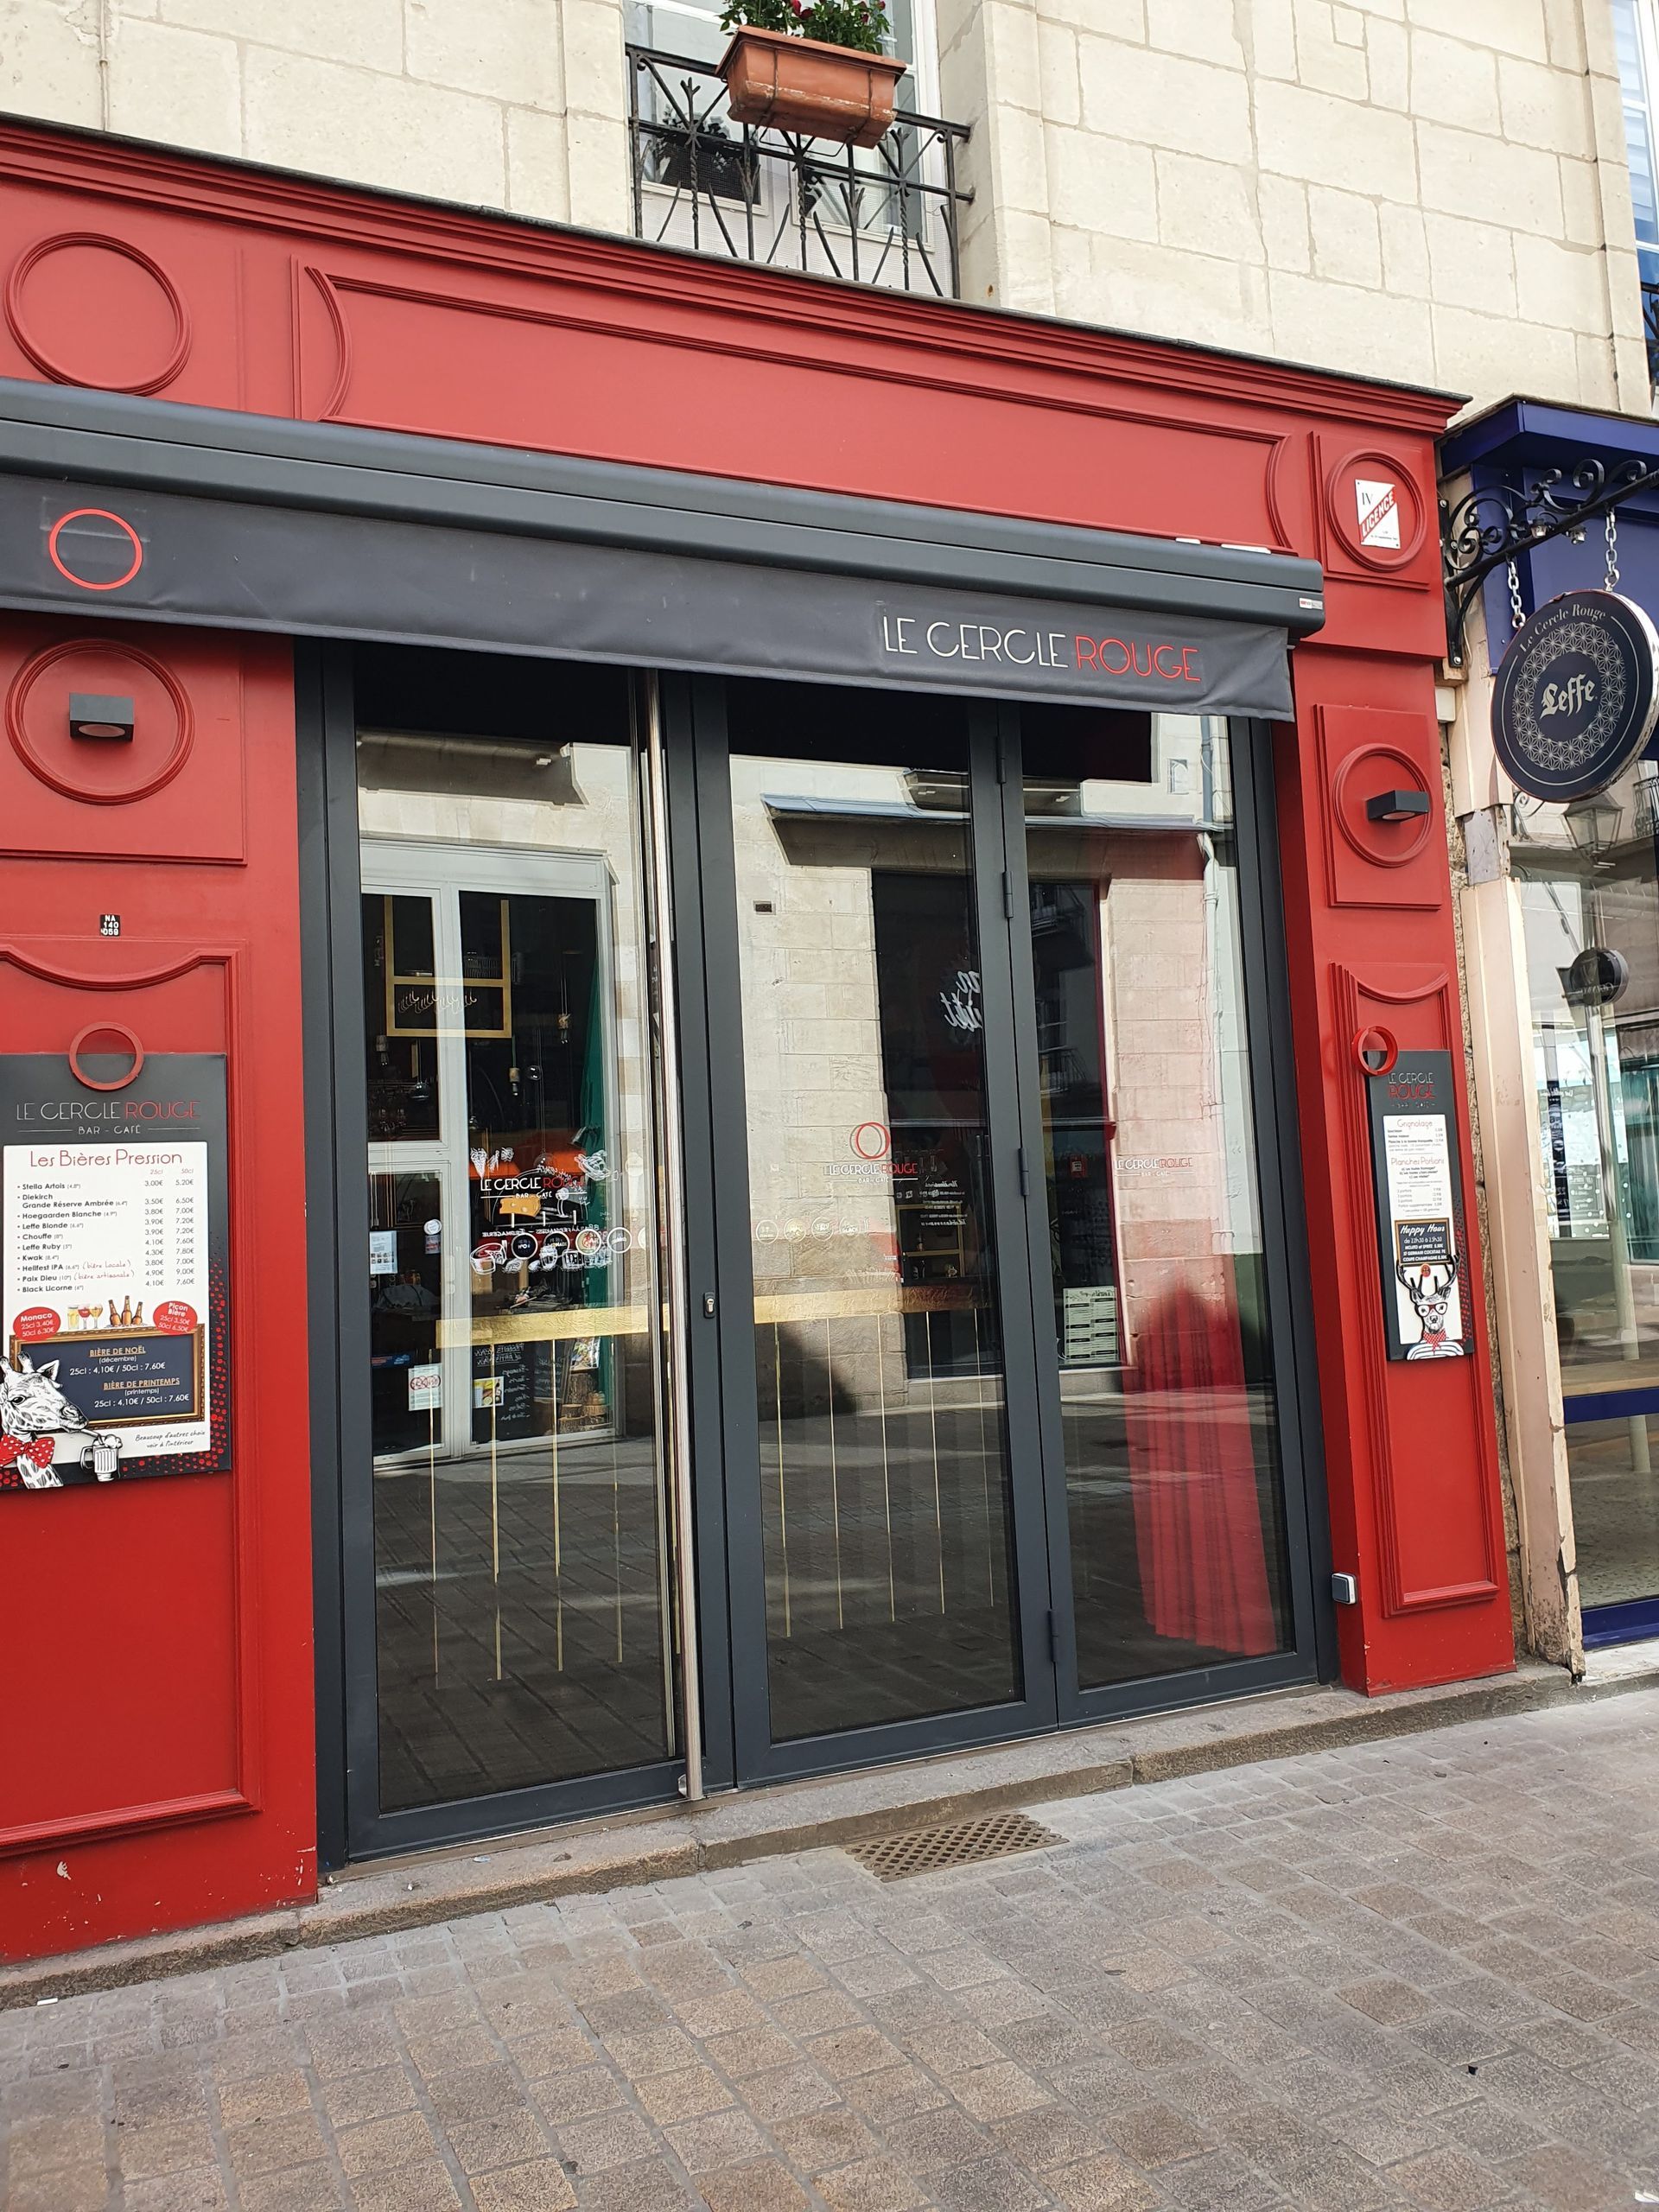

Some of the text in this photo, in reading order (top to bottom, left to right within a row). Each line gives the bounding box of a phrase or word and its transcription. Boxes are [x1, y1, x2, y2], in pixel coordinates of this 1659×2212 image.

[1362, 492, 1374, 505] IV
[1361, 490, 1395, 539] LICENCE
[1519, 603, 1606, 652] Le Cercle Rouge
[883, 615, 1201, 682] LE CERCLE ROUGE
[1539, 673, 1596, 720] Leffe
[16, 1100, 200, 1121] LE CERCLE ROUGE
[78, 1126, 100, 1135] BAR
[30, 1148, 182, 1167] Les Bières Pression
[480, 1179, 492, 1192] LE
[493, 1177, 541, 1191] CERCLE
[1400, 1224, 1445, 1236] Happy Hour
[20, 1313, 53, 1323] Monaco
[89, 1347, 111, 1357] BIÈRE
[124, 1345, 146, 1355] NOËL
[99, 1355, 137, 1364] (décembre)
[69, 1367, 86, 1376] 25cl
[103, 1380, 124, 1390] BIÈRE
[138, 1377, 180, 1388] PRINTEMPS
[124, 1388, 160, 1396] (printemps)
[146, 1395, 162, 1404] 50cl
[135, 1433, 163, 1442] Beaucoup
